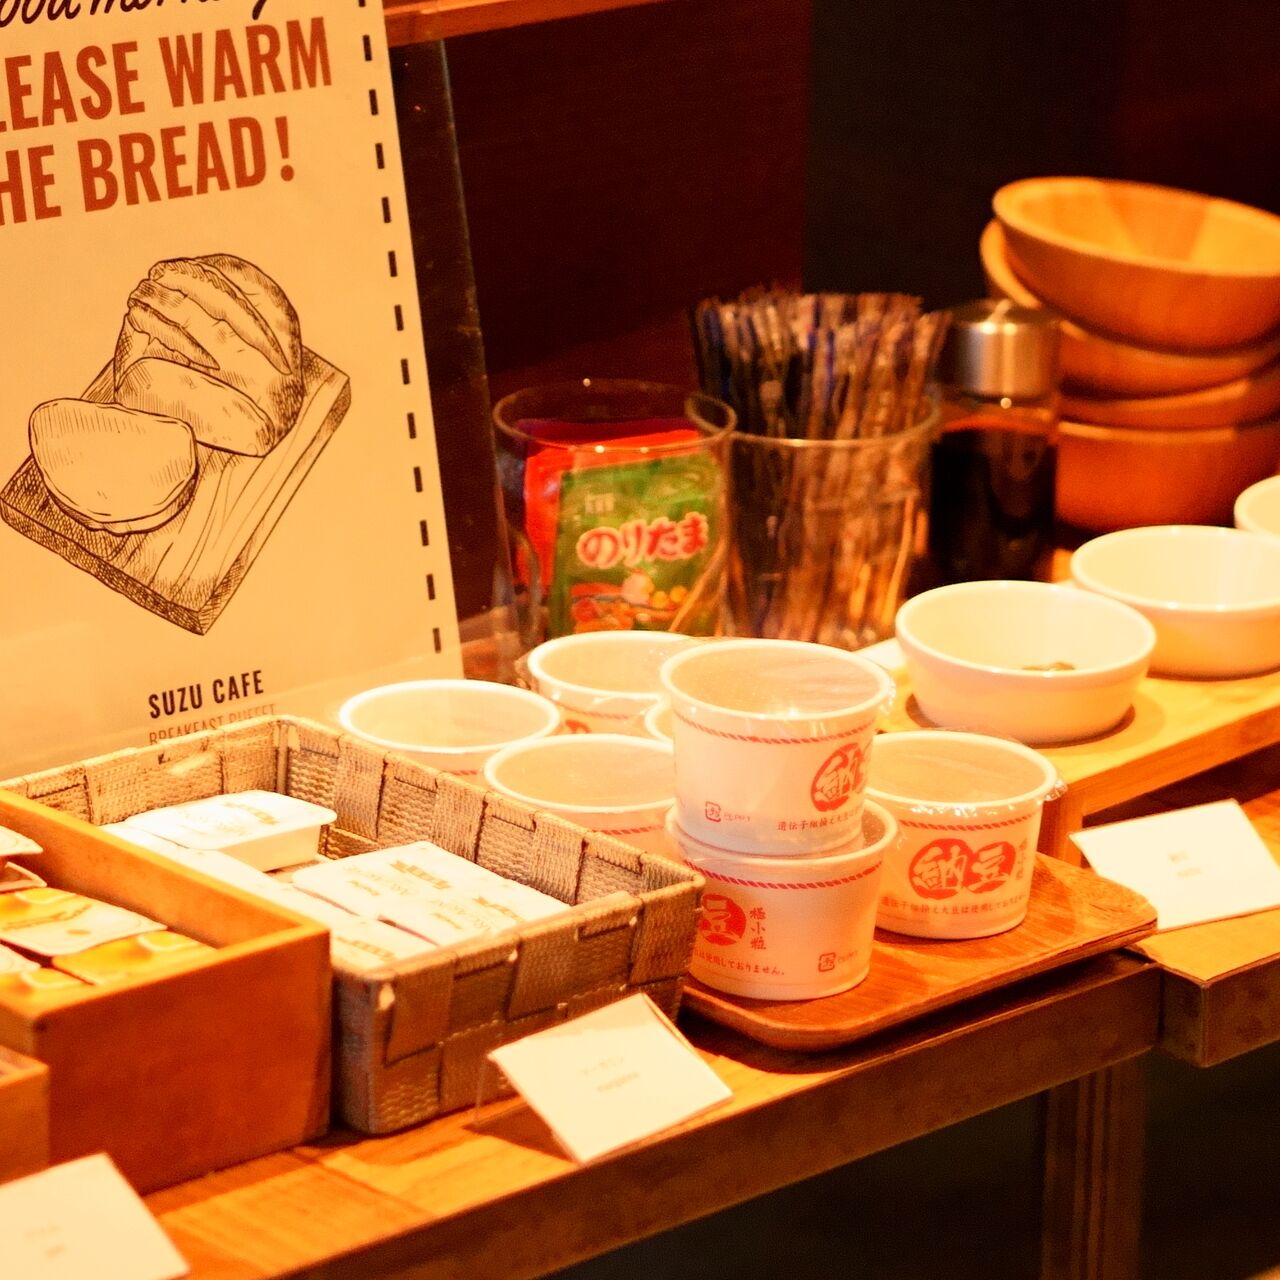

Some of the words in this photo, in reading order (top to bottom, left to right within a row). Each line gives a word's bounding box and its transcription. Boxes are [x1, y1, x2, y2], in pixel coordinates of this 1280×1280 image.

[158, 16, 333, 108] WARM
[576, 511, 708, 569] のりたま
[148, 683, 203, 719] SUZU
[212, 670, 264, 704] CAFE
[908, 838, 1017, 900] 納豆
